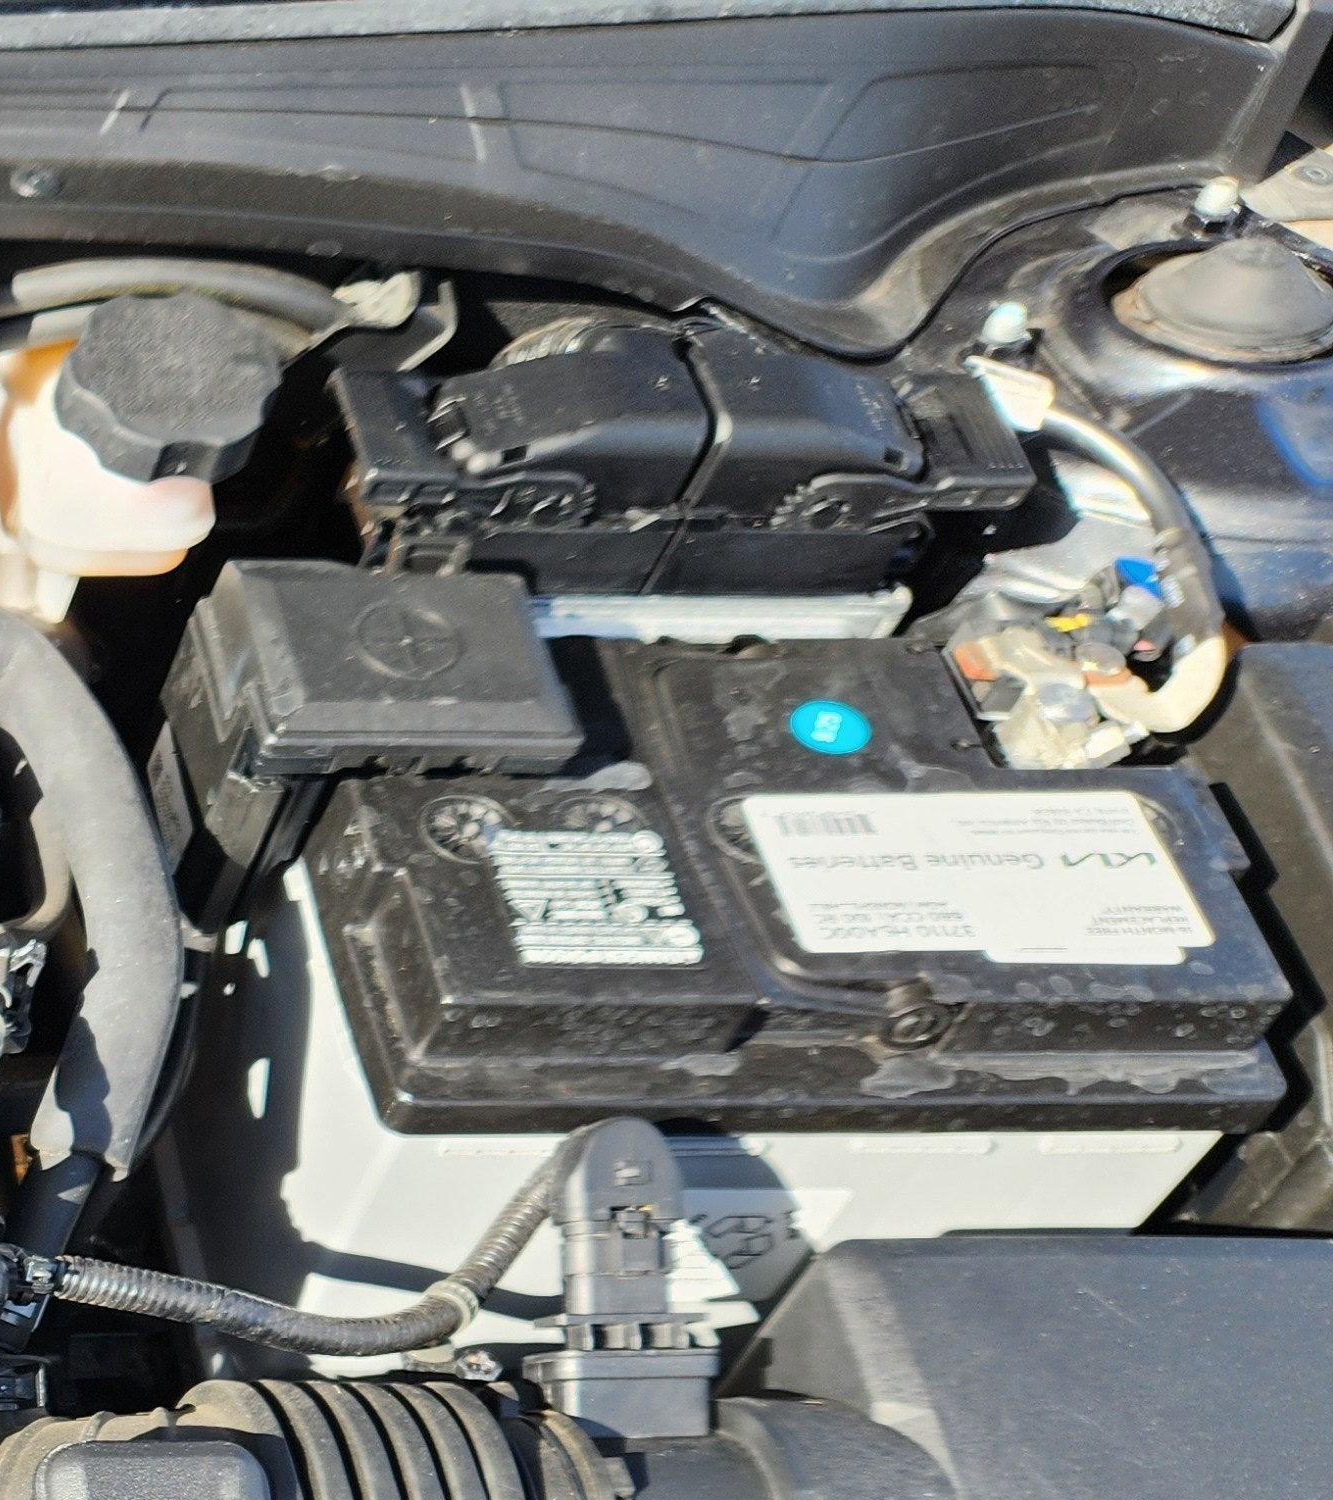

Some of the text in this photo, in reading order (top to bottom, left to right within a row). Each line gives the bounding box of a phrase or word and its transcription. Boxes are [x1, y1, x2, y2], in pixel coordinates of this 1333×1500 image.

[787, 852, 1157, 872] KIA Genuine Batteries
